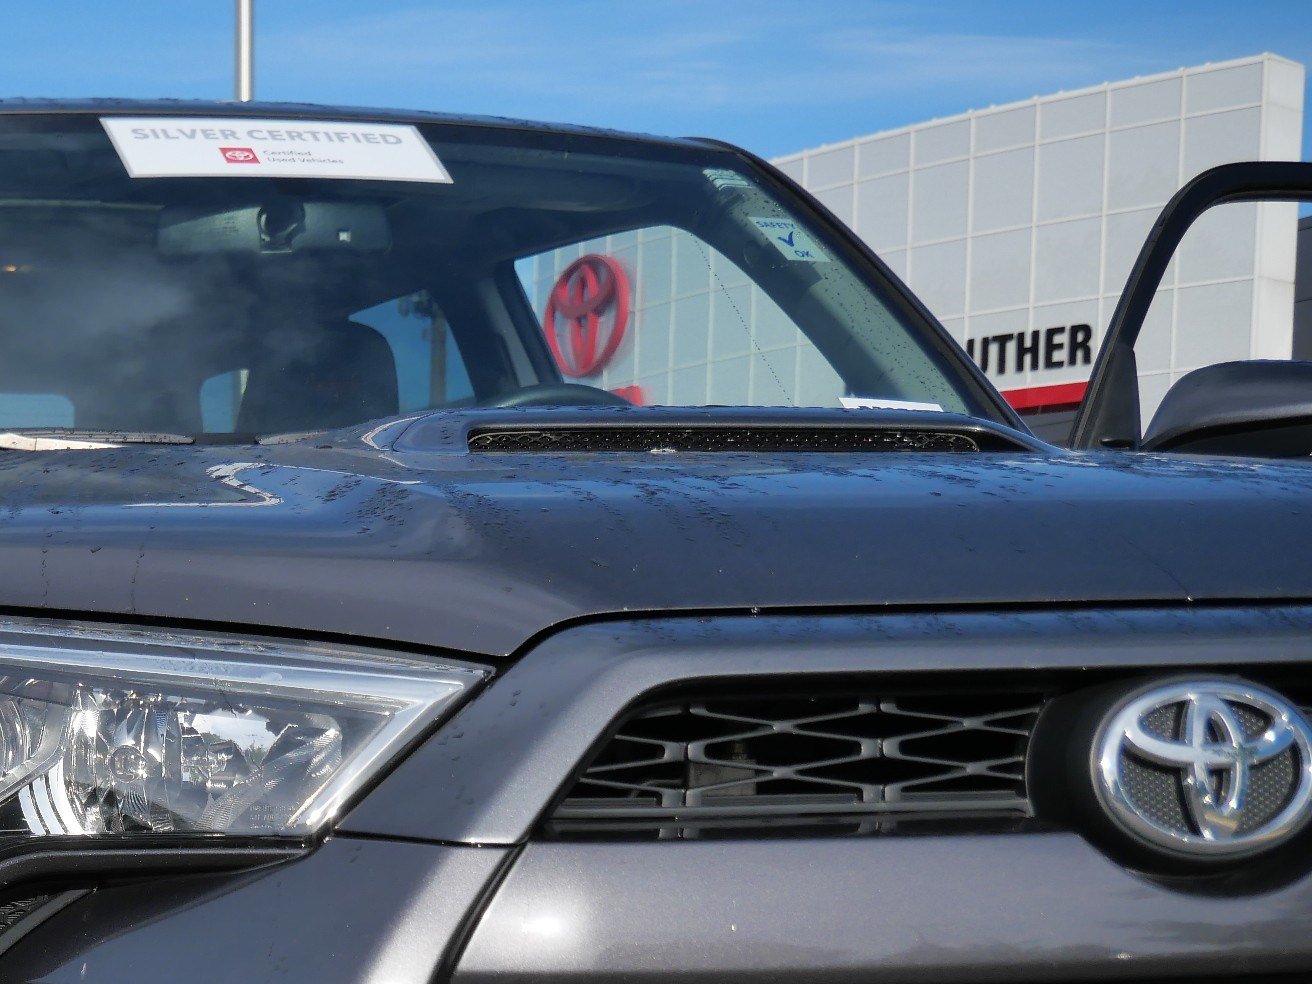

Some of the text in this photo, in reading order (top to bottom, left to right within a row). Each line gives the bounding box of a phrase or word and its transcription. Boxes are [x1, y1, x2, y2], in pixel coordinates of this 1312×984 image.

[131, 127, 403, 146] SILVER CERTIFIED
[794, 249, 814, 258] OK
